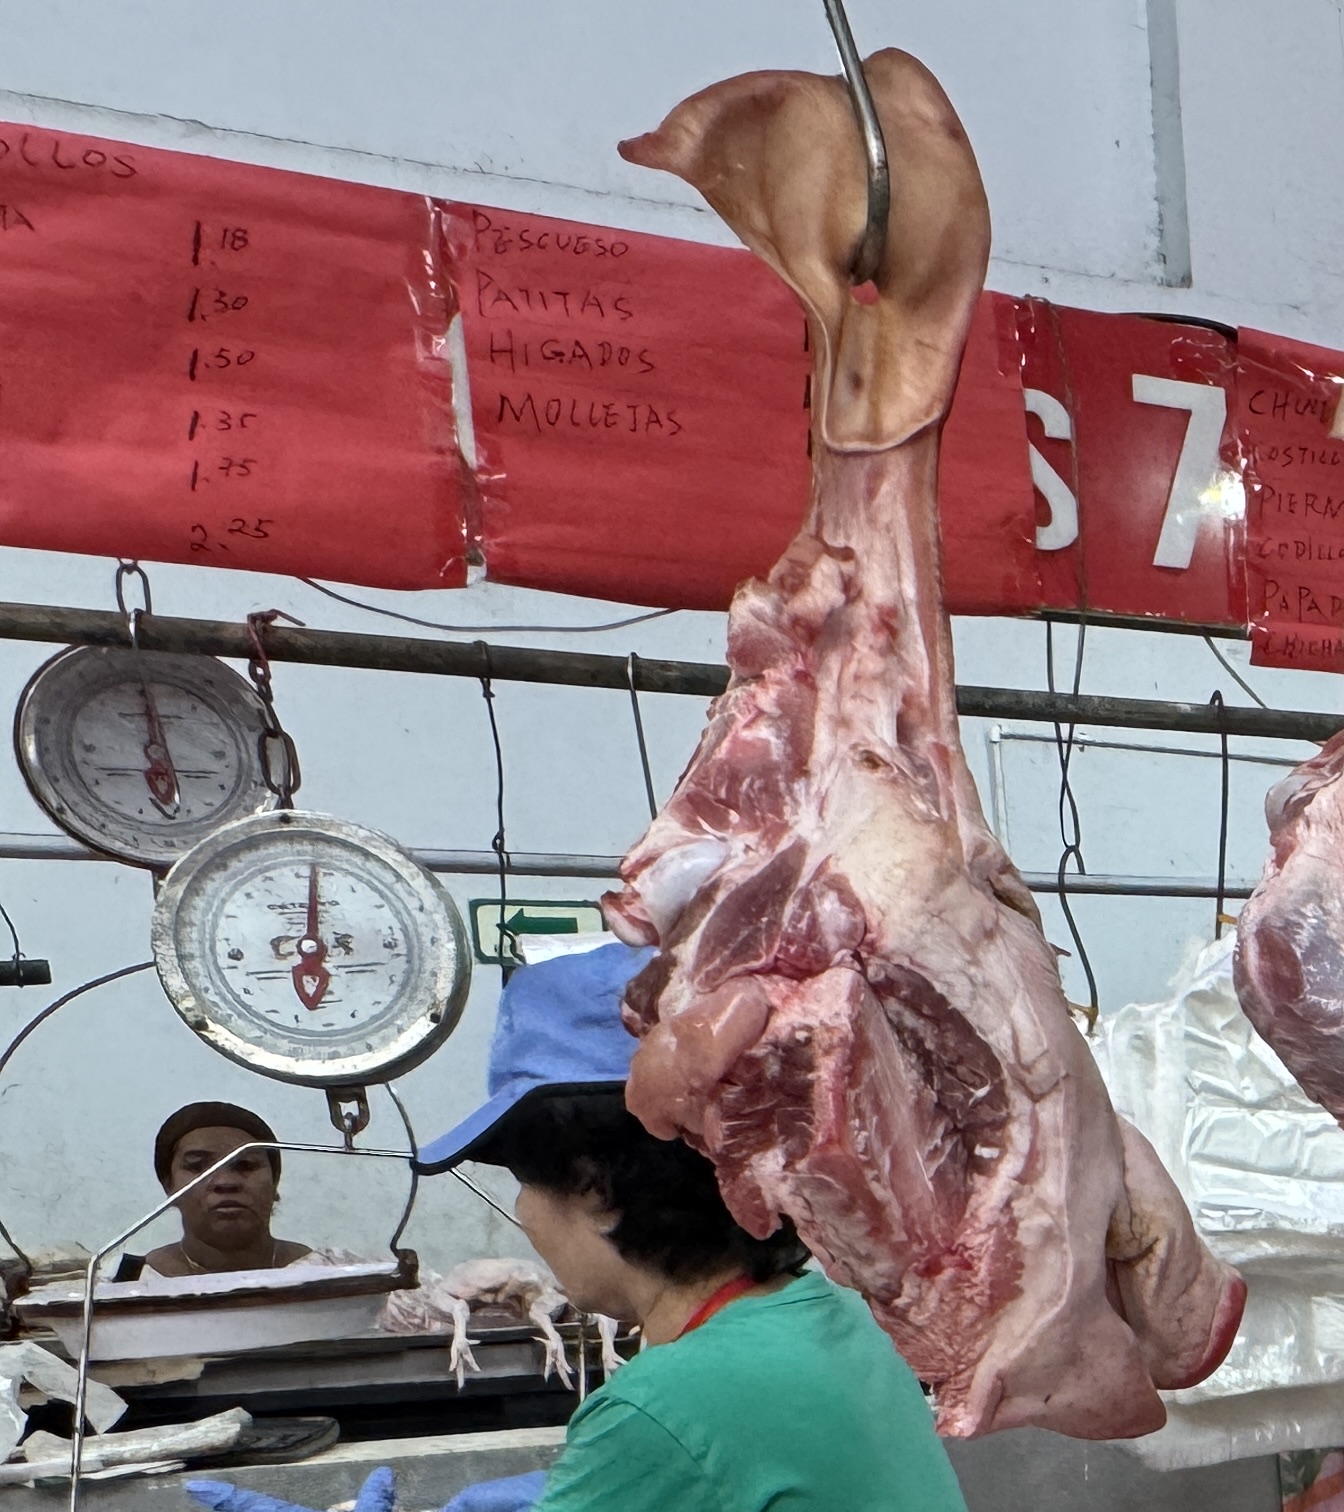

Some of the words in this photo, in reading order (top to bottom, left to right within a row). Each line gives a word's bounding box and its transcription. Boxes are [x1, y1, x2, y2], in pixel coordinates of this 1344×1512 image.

[476, 270, 634, 320] PATITAS
[188, 348, 255, 381] 1.50
[490, 330, 655, 375] HIGADOS
[499, 393, 682, 436] MOLLEJAS
[191, 459, 258, 491] 1.75
[1132, 374, 1227, 569] 7
[190, 517, 275, 552] 2.25
[1264, 579, 1344, 623] PAPAD
